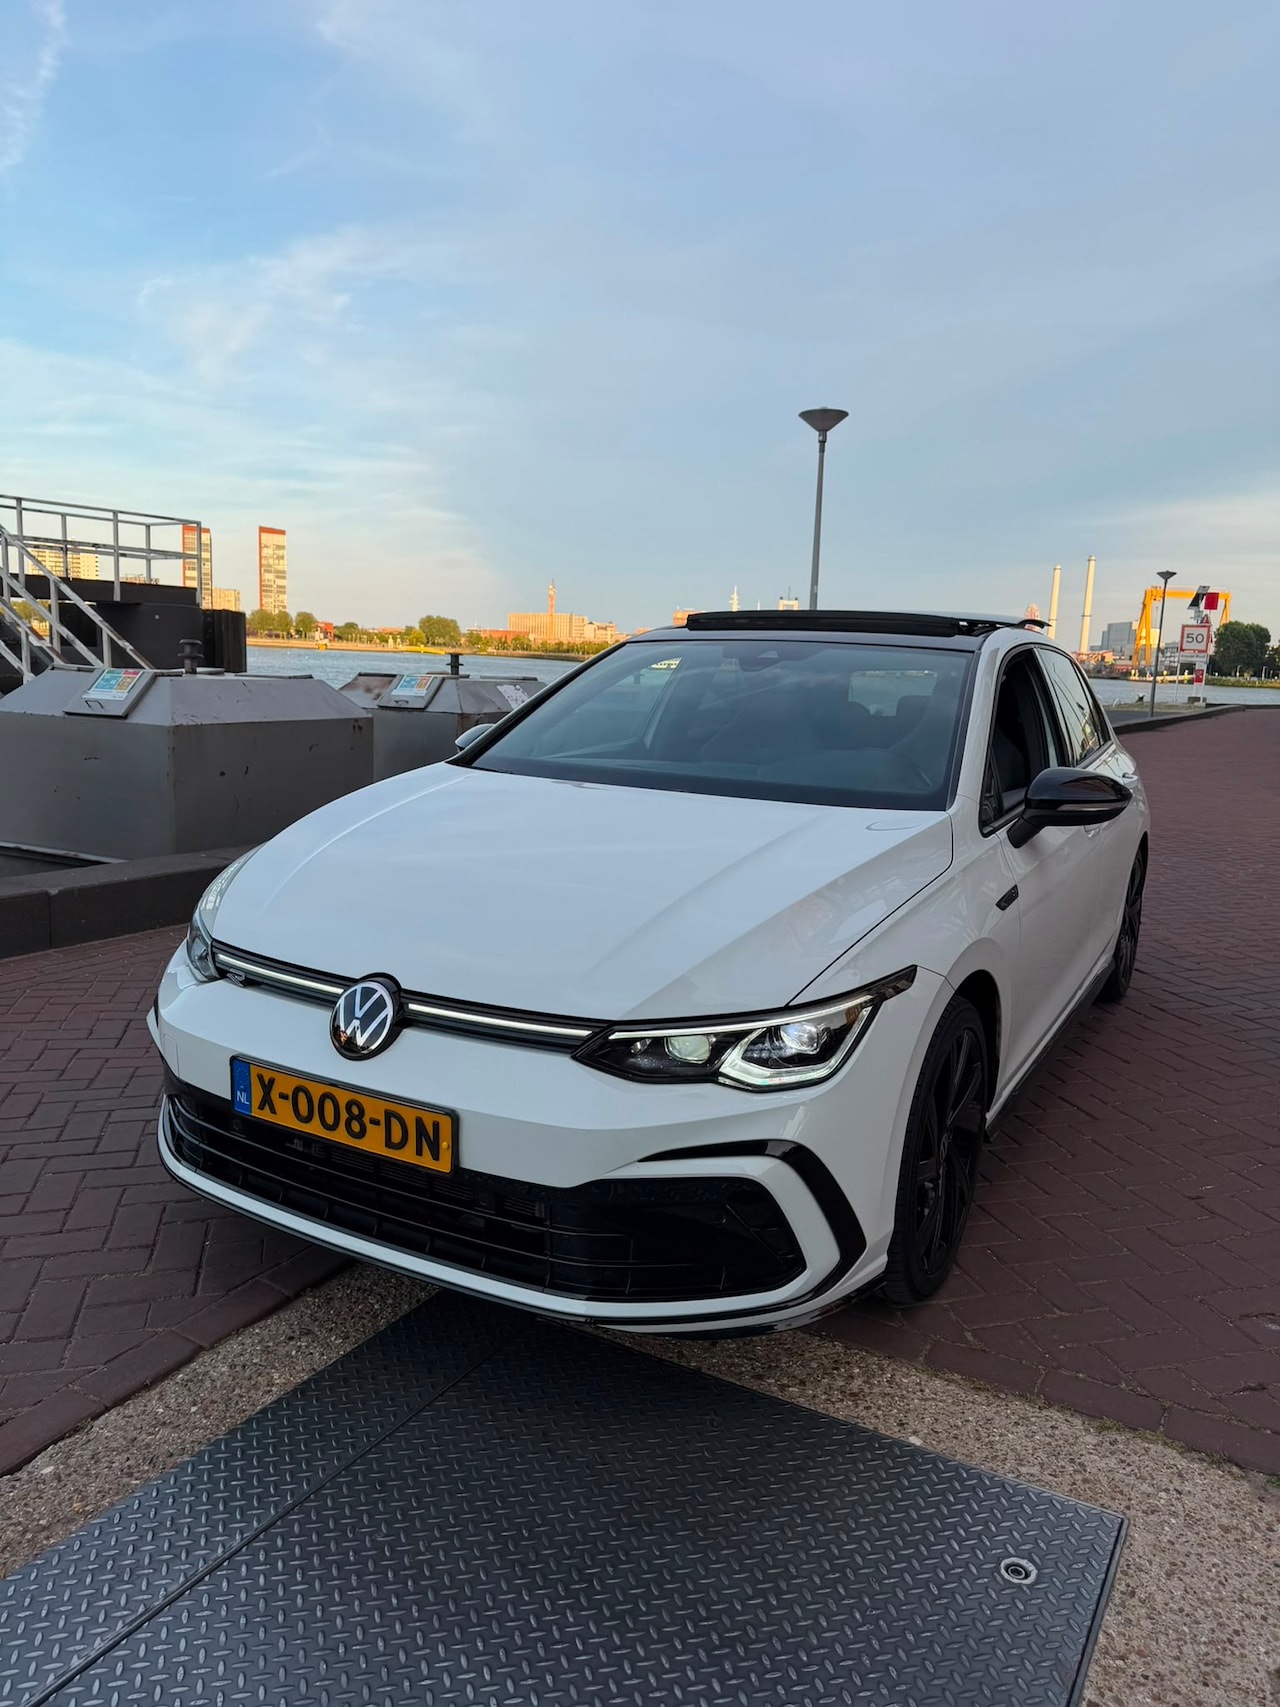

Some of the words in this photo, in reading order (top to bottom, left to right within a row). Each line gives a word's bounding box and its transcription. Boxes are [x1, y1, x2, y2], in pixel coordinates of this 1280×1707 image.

[1186, 633, 1205, 644] 50
[335, 982, 393, 1053] VW
[236, 1090, 249, 1105] NL
[256, 1073, 441, 1162] X-008-DN
